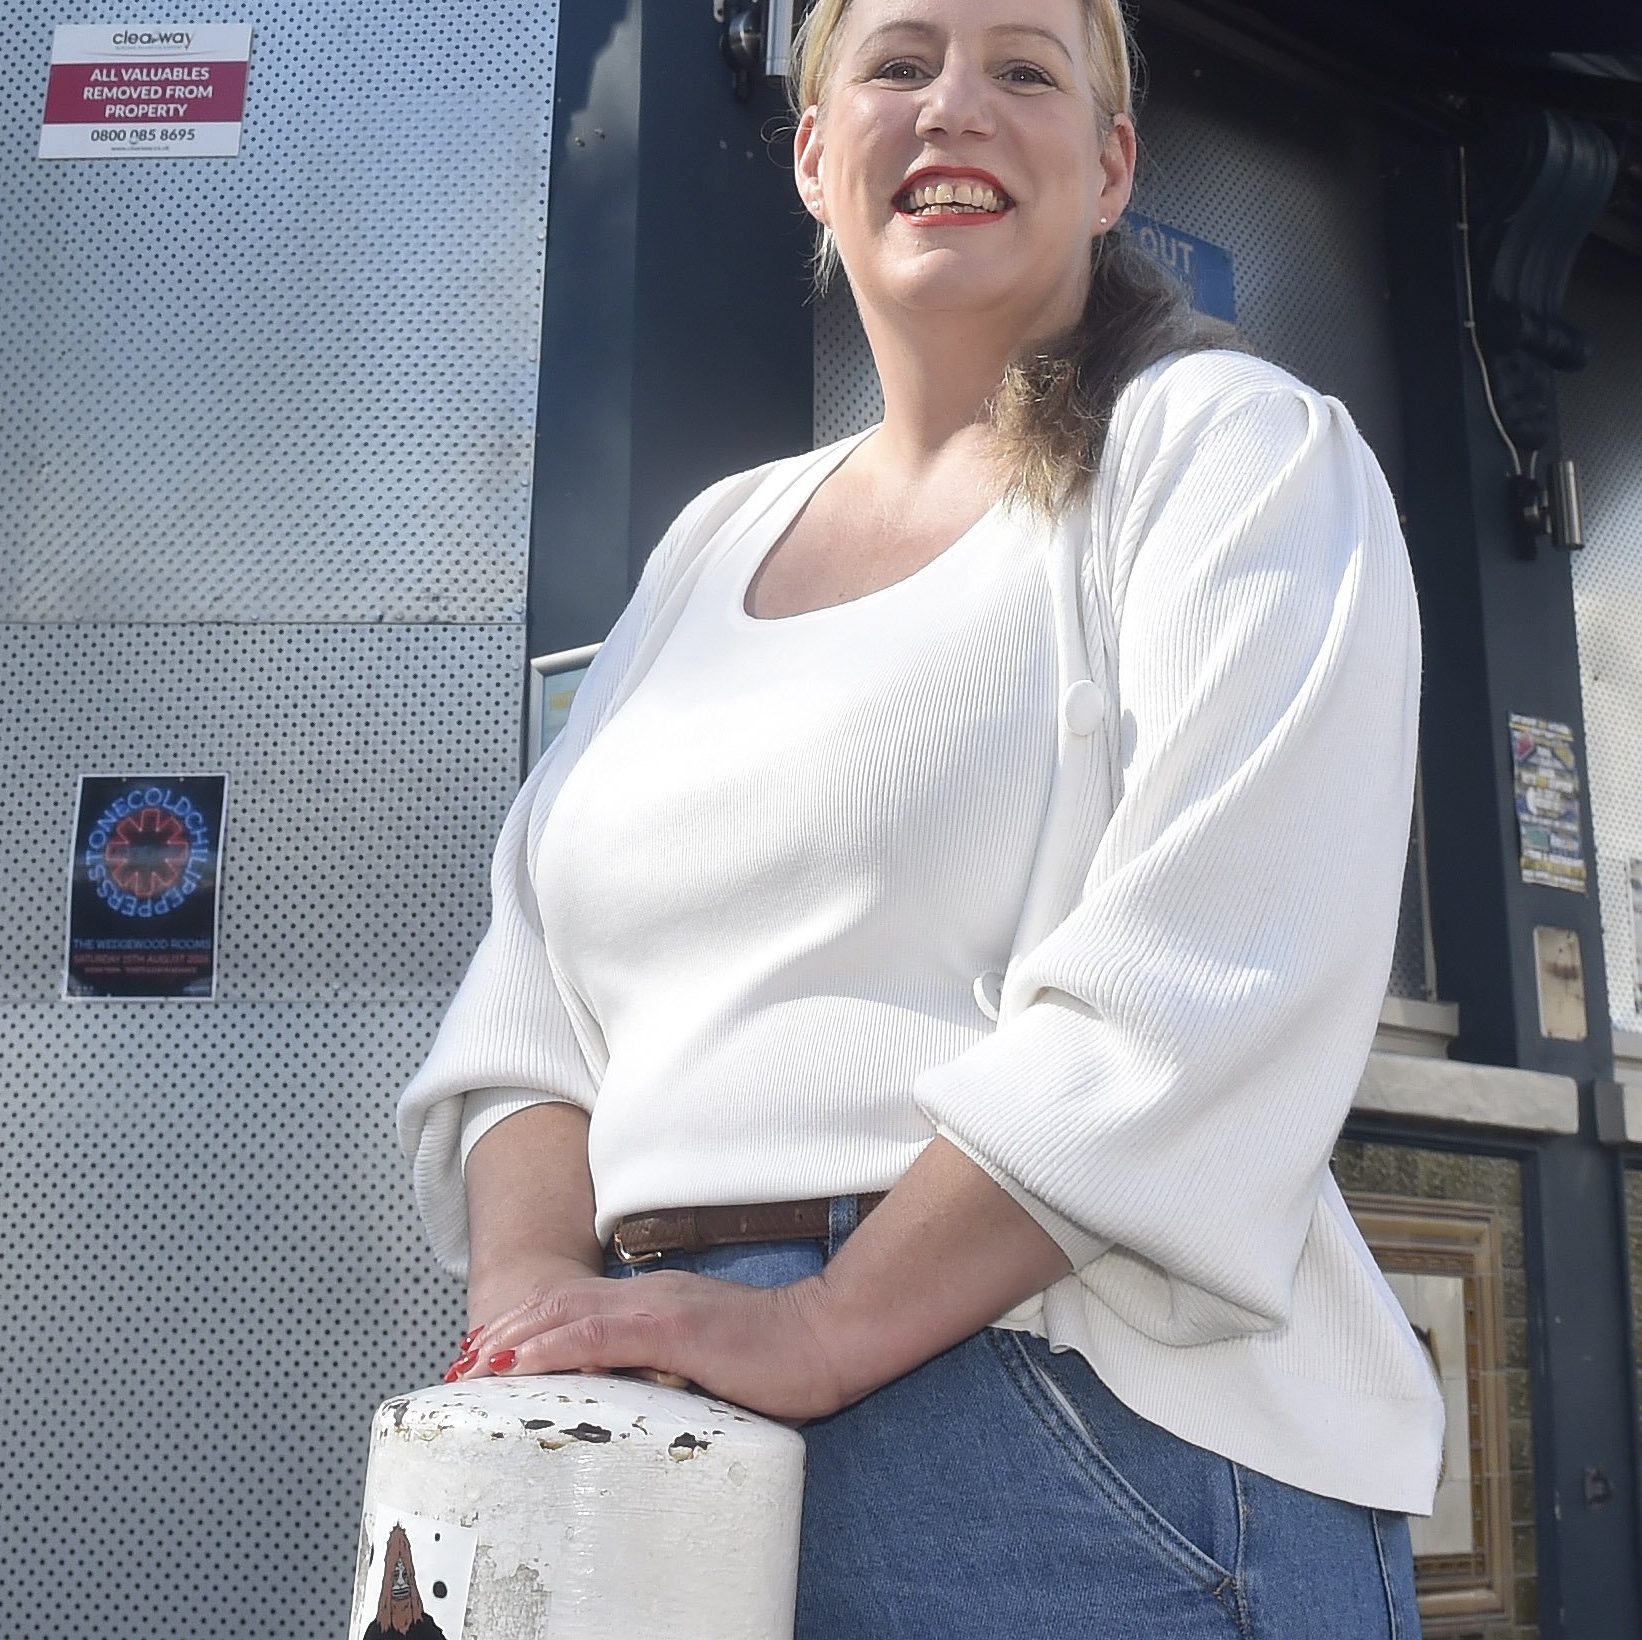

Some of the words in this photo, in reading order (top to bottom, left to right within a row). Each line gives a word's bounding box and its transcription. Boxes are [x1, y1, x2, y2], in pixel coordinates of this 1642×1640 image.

[90, 68, 118, 81] ALL
[121, 67, 209, 81] VALUABLES
[83, 85, 162, 100] REMOVED
[165, 85, 213, 98] FROM
[105, 103, 188, 118] PROPERTY
[90, 129, 126, 142] 0800
[160, 128, 196, 141] 8695
